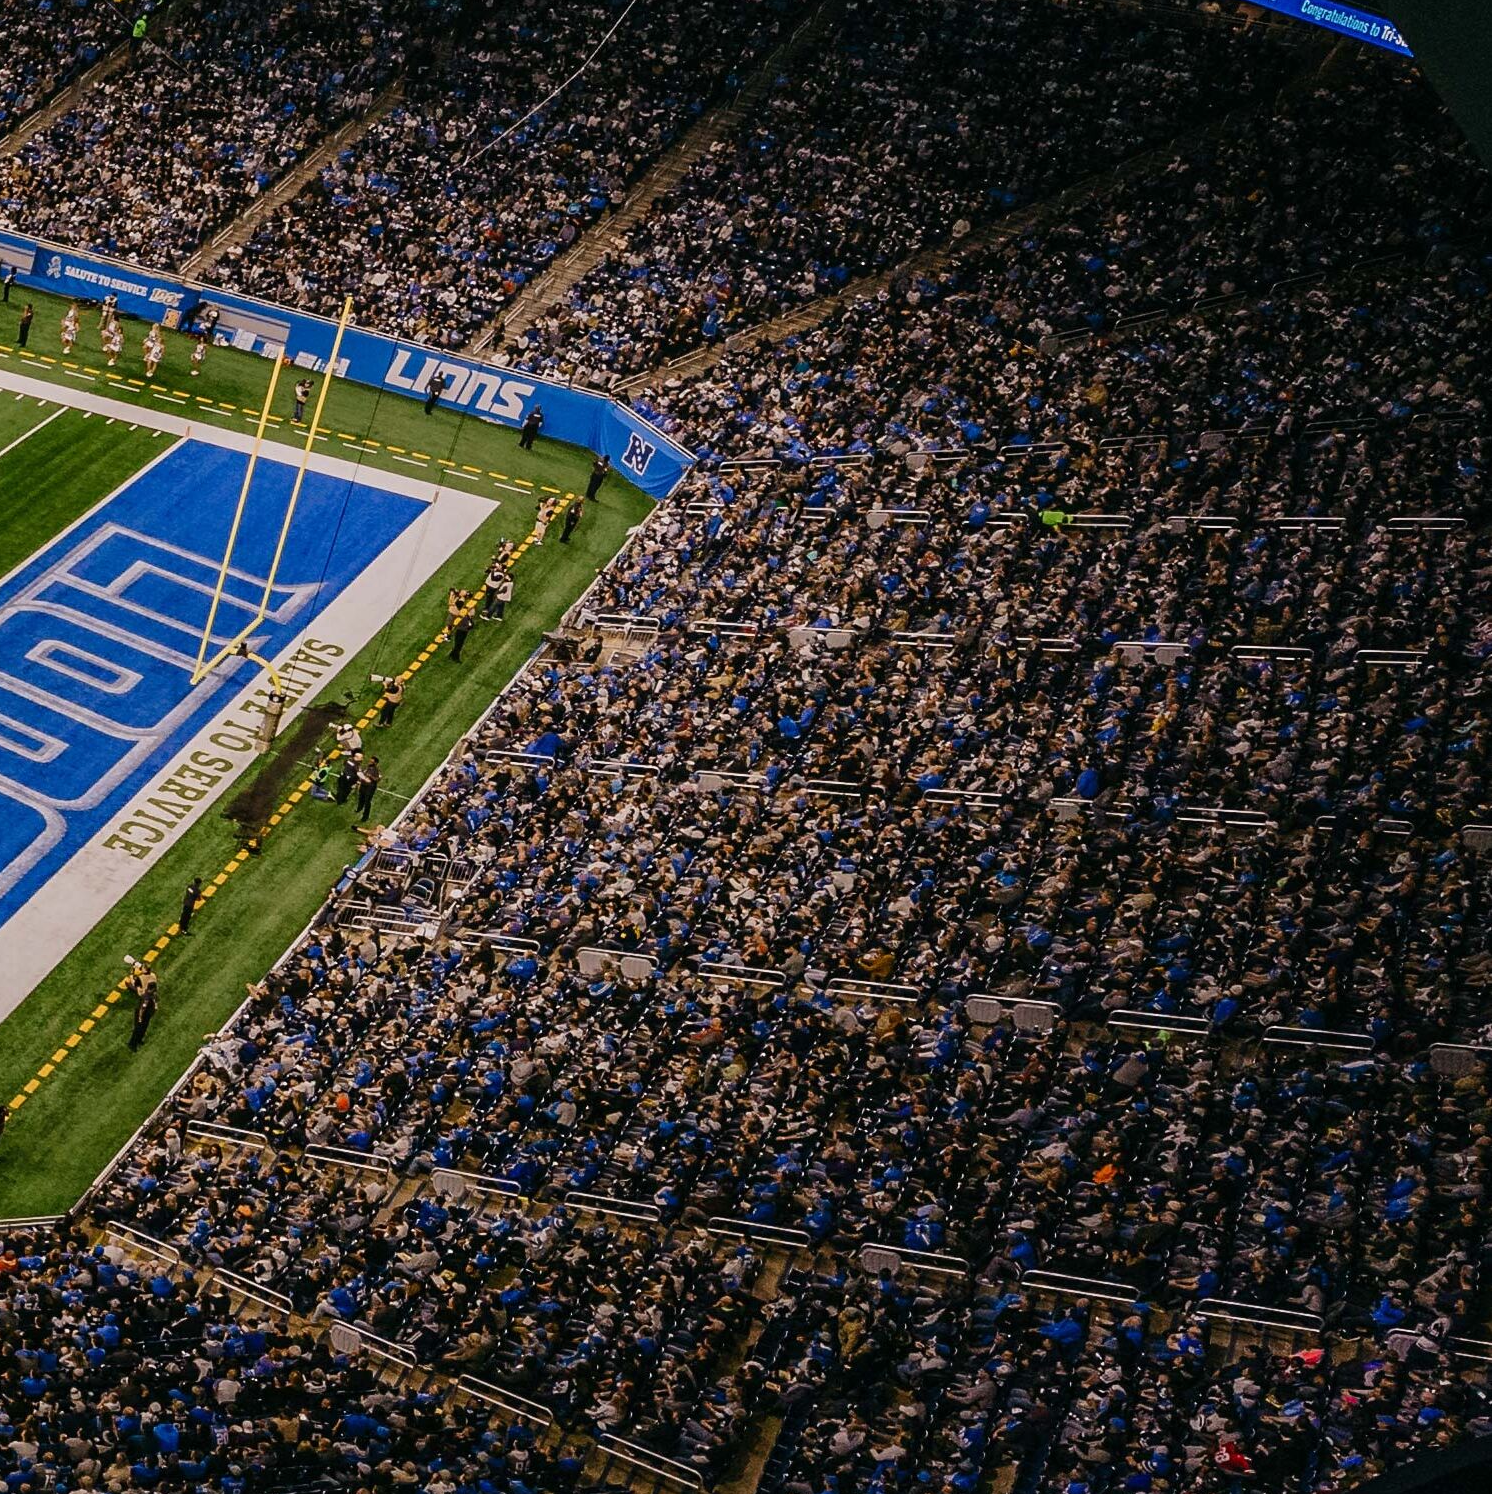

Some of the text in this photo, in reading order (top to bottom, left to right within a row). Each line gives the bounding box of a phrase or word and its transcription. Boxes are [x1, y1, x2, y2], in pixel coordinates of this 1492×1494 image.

[1300, 0, 1369, 32] Congratulations
[1369, 23, 1380, 37] to
[64, 265, 148, 297] SALUTE TO SERVICE
[384, 347, 536, 422] LIONS
[209, 719, 262, 753] TO
[100, 750, 234, 860] SERVICE
